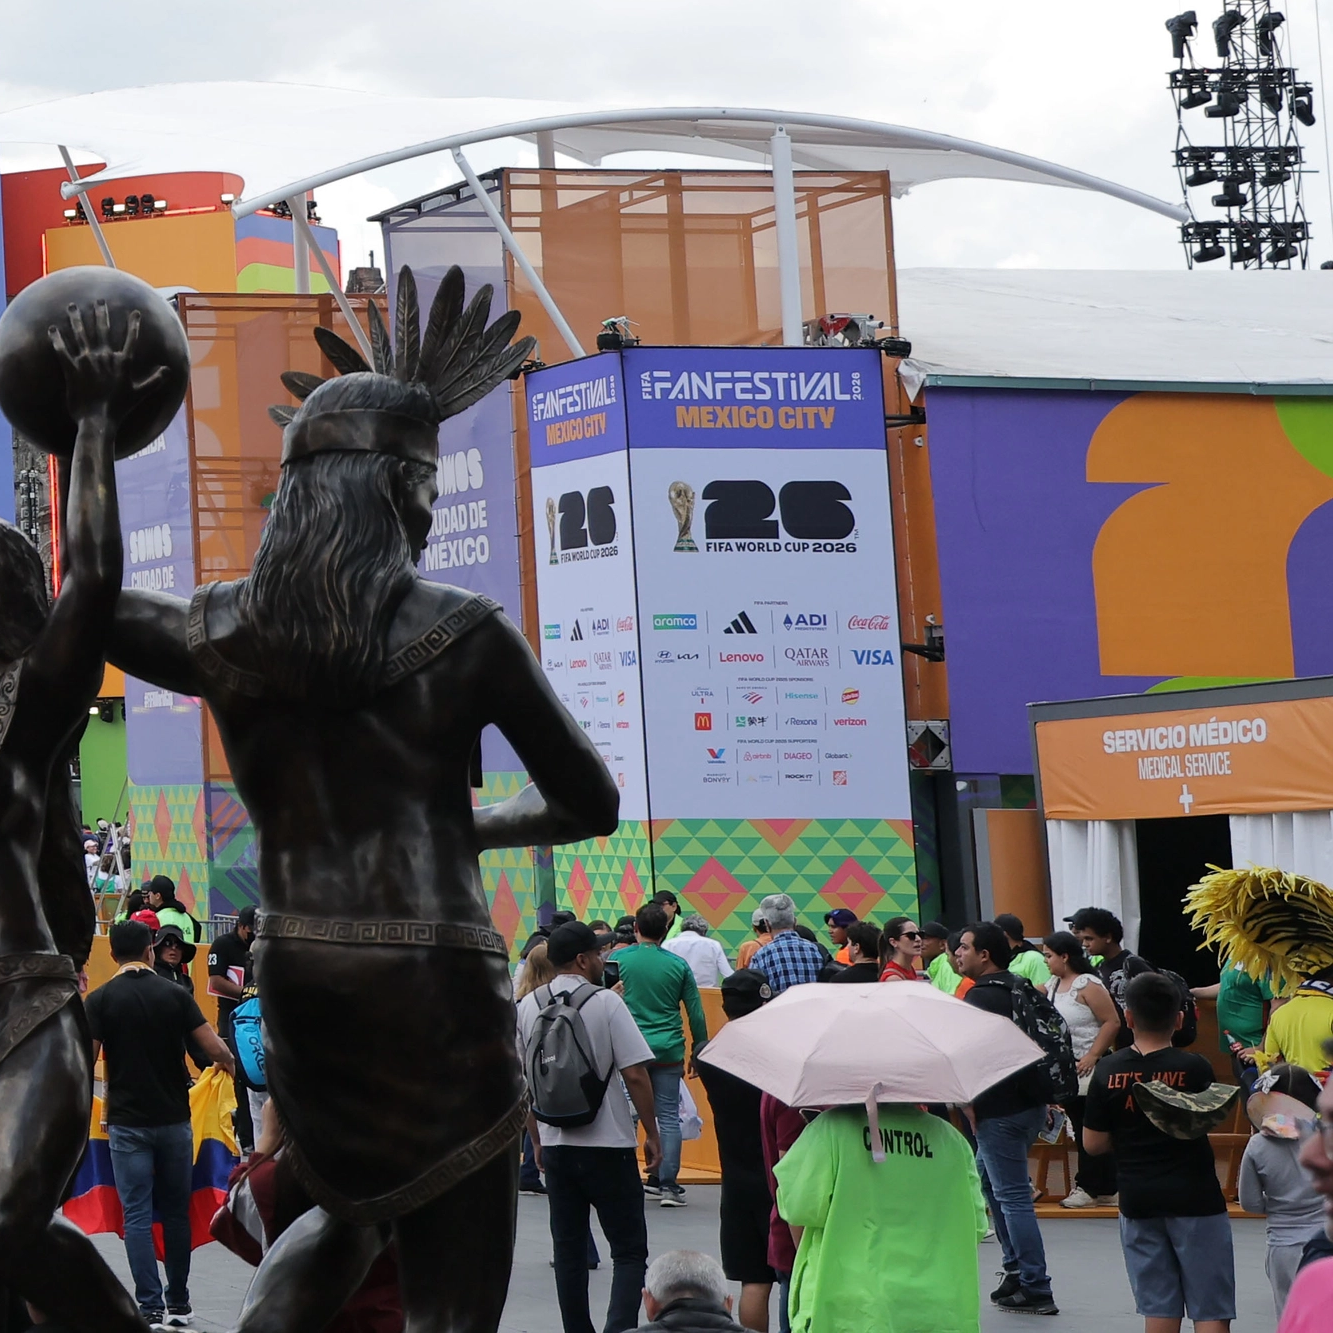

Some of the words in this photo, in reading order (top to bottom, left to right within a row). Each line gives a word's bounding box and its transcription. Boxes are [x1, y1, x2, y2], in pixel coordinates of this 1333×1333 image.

[640, 371, 652, 399] FIFA
[852, 372, 862, 400] 2026
[676, 405, 774, 428] MEXICO
[779, 406, 835, 429] CITY
[546, 417, 583, 446] MEXICO
[584, 412, 606, 438] CITY
[435, 448, 484, 497] OMOS
[558, 485, 616, 550] 26
[702, 480, 855, 540] 26
[426, 503, 468, 538] IUDAD
[468, 500, 488, 529] DE
[129, 524, 173, 563] SOMOS
[706, 542, 733, 553] FIFA
[735, 542, 782, 553] WORLD
[785, 542, 809, 553] CUP
[812, 542, 857, 553] 2026
[424, 534, 490, 571] MÉXICO
[561, 553, 571, 563] FIFA
[572, 550, 589, 562] WORLD
[590, 549, 600, 559] CUP
[601, 546, 618, 557] 2026
[162, 566, 174, 589] DE
[654, 617, 696, 627] aramco
[795, 614, 827, 626] ADI
[619, 651, 636, 666] VISA
[720, 652, 764, 663] Lenovo
[785, 648, 828, 660] QATAR
[850, 649, 894, 666] VISA
[796, 659, 830, 667] AIRWAYS
[785, 692, 819, 700] Hisense
[790, 718, 817, 726] Rexona
[834, 717, 867, 726] verizon
[1103, 725, 1186, 754] SERVICIO
[1189, 716, 1267, 747] MÉDICO
[784, 752, 812, 760] DIAGEO
[1138, 755, 1185, 780] MEDICAL
[1185, 751, 1231, 777] SERVICE
[208, 953, 217, 965] 23
[1108, 1072, 1141, 1089] LET'S
[1124, 1095, 1133, 1110] A
